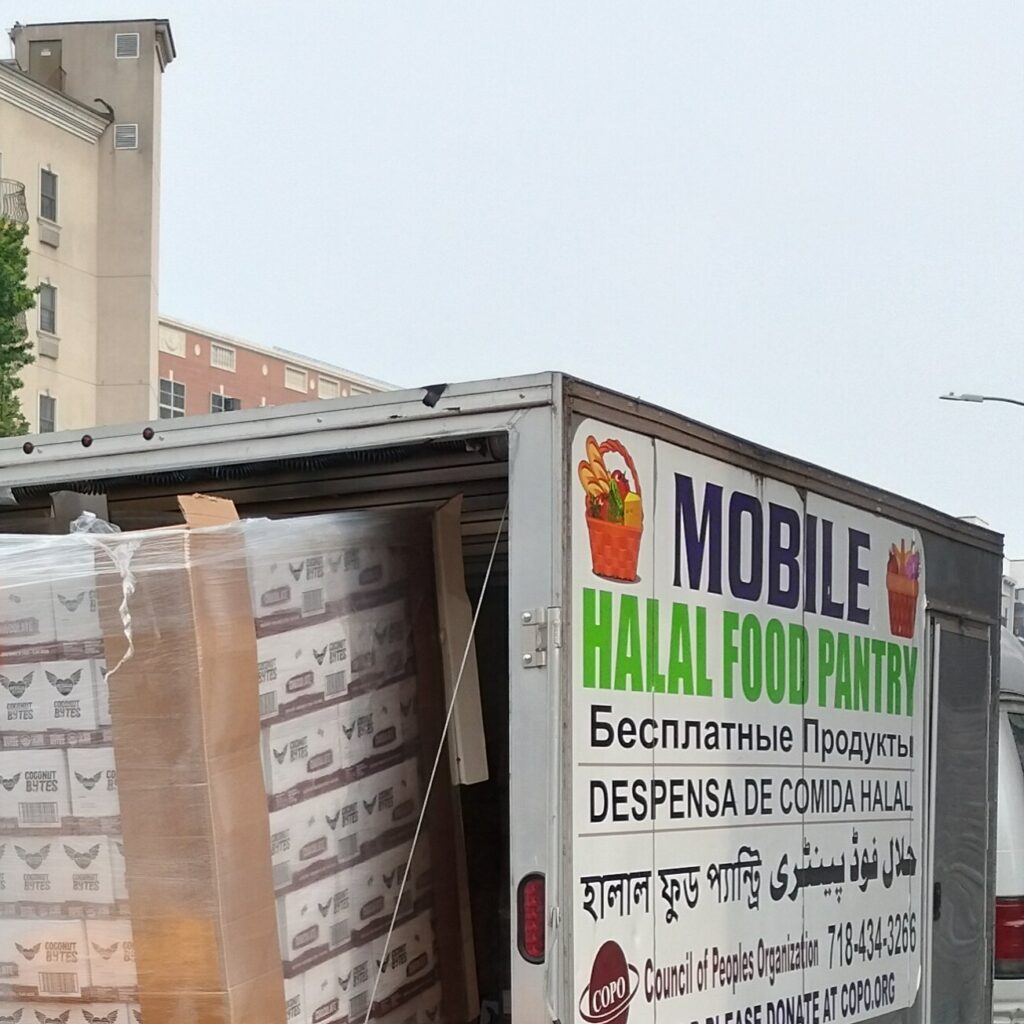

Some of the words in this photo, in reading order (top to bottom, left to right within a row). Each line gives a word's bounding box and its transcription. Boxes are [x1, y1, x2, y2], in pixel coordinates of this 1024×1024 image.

[674, 472, 870, 624] MOBILE
[583, 587, 713, 697] HALAL
[723, 610, 809, 704] FOOD
[818, 628, 918, 717] PANTRY
[7, 710, 34, 720] BYTES
[54, 708, 81, 719] BYTES
[590, 704, 793, 752] Бесплатные
[803, 718, 914, 764] Продукты
[26, 780, 58, 792] BYTES
[590, 779, 738, 822] DESPENSA
[744, 779, 772, 816] DE
[780, 778, 856, 814] COMIDA
[861, 779, 913, 812] HALAL
[882, 835, 917, 888] حلال
[580, 871, 652, 921] হালাল
[658, 866, 701, 924] ফুড
[46, 950, 78, 963] BYTES
[644, 951, 694, 1003] Council
[696, 948, 709, 992] of
[712, 943, 754, 994] Peoples
[757, 931, 819, 986] Organization
[828, 912, 917, 970] 718-434-3266
[592, 976, 626, 1014] COPO
[822, 986, 838, 1023] AT
[840, 972, 896, 1018] COPO.ORG
